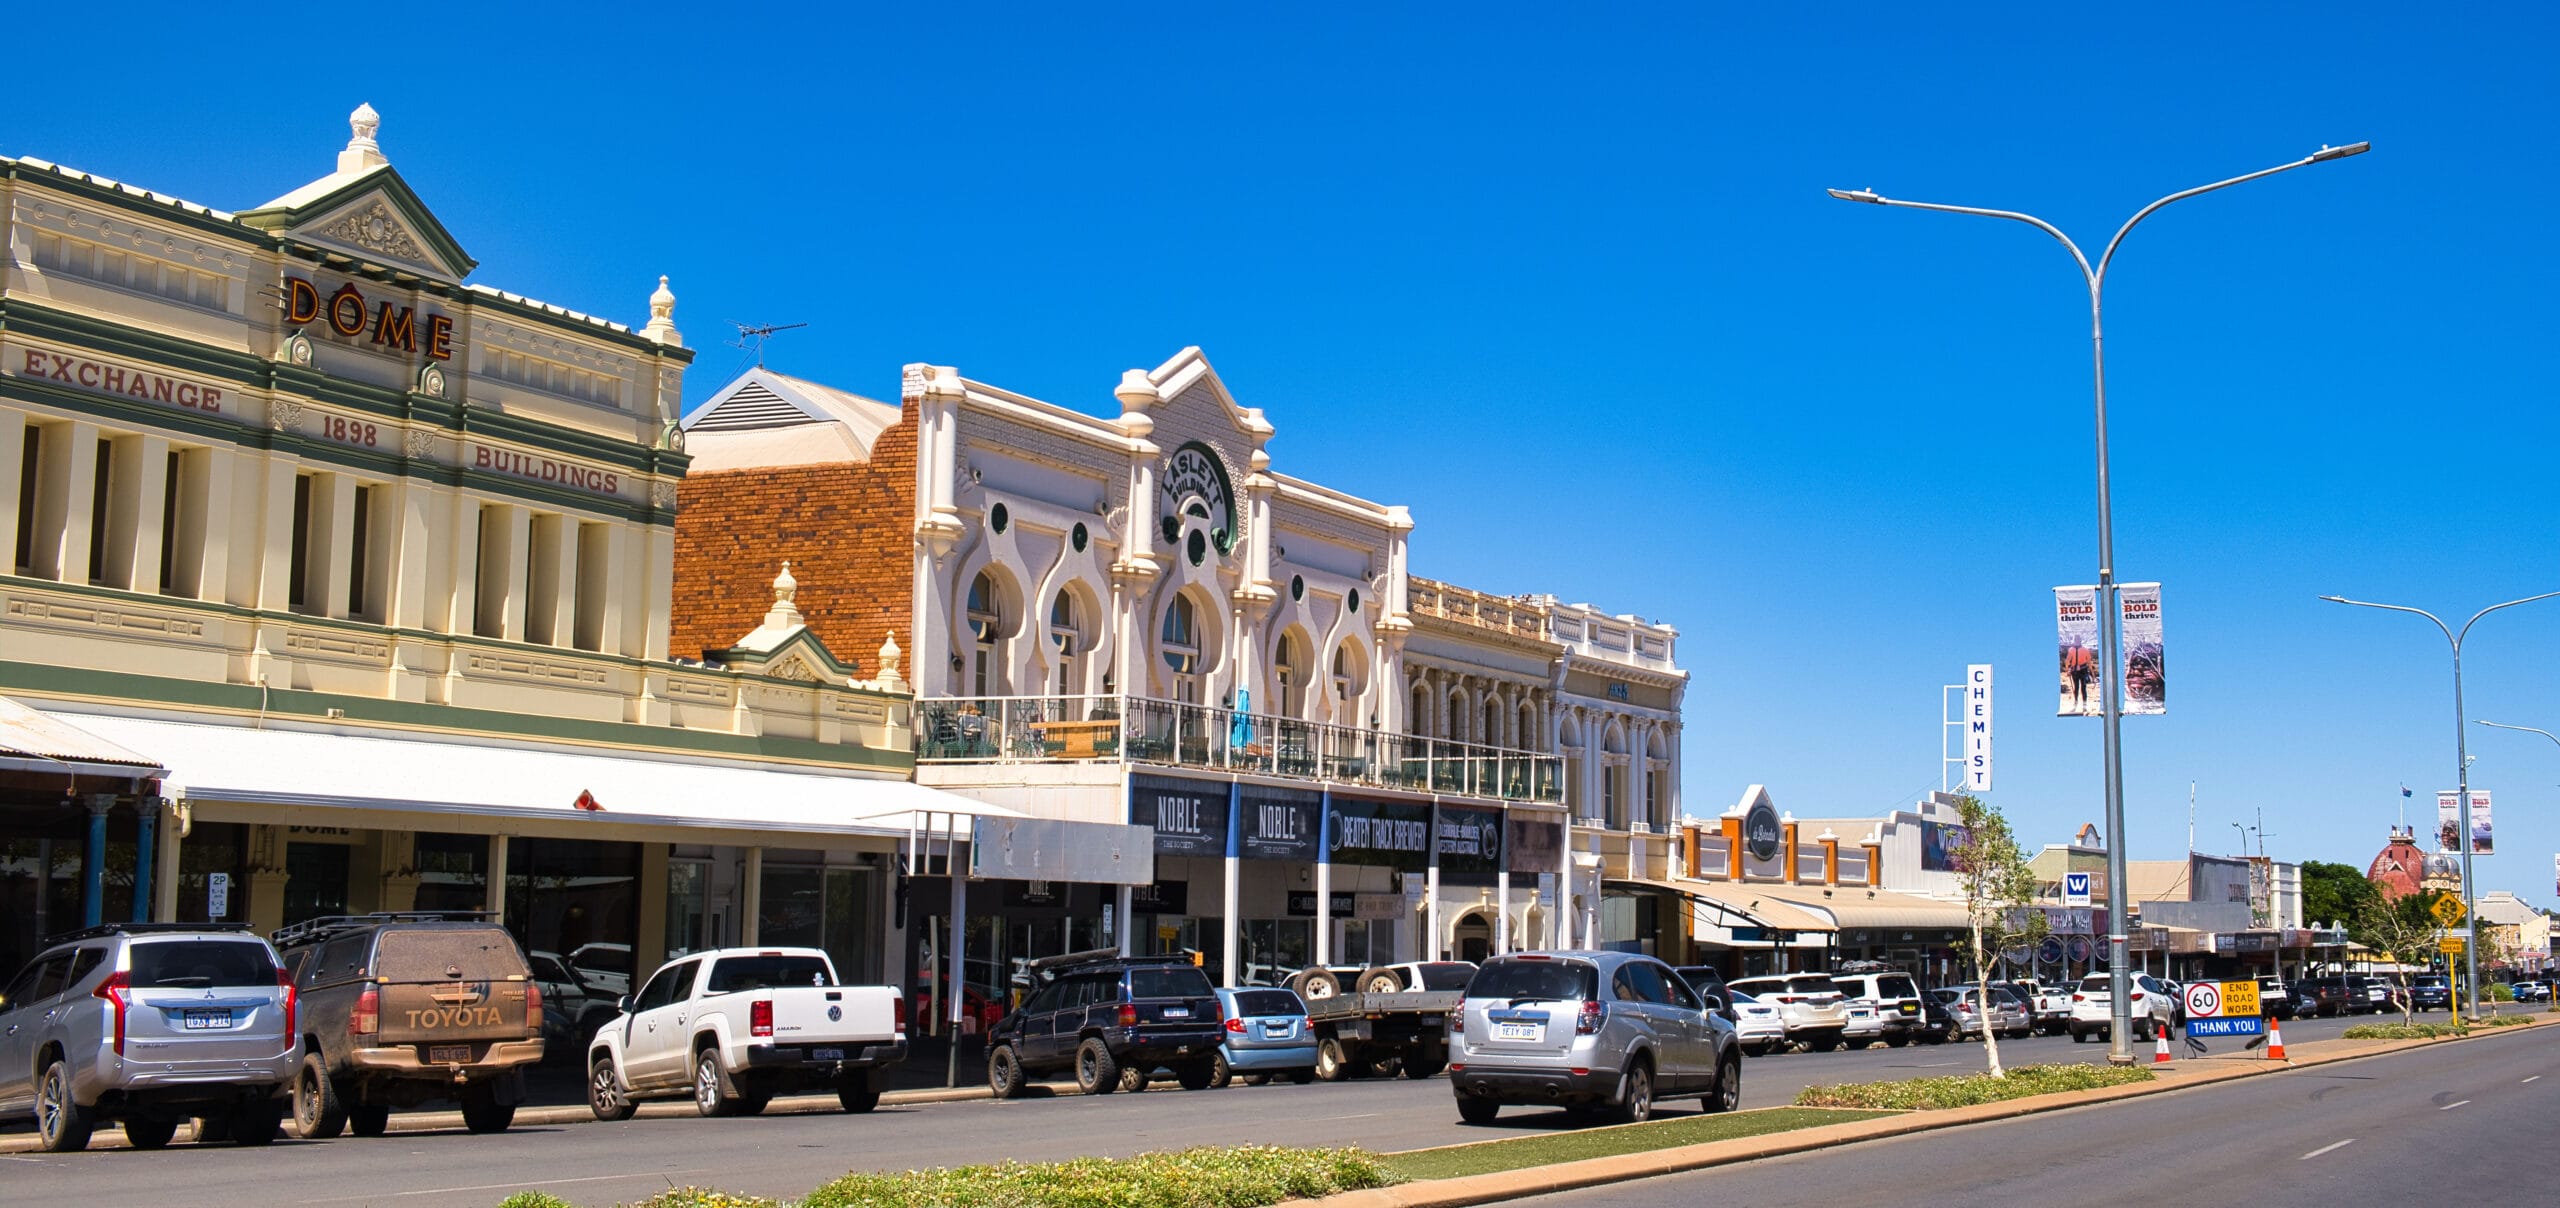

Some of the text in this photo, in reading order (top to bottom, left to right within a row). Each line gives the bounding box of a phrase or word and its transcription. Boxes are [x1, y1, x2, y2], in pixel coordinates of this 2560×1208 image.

[287, 278, 455, 360] DÔME
[24, 348, 222, 413] EXCHANGE
[322, 415, 378, 447] 1898
[474, 444, 619, 494] BUILDINGS
[1162, 453, 1224, 505] LASLETT
[1171, 477, 1214, 510] BUILDINGS
[2060, 606, 2093, 615] BOLD
[2061, 614, 2094, 622] thrive.
[2124, 604, 2158, 613] BOLD
[2125, 612, 2159, 620] thrive.
[1973, 670, 1986, 784] CHEMIST
[1158, 796, 1201, 833] NOBLE
[1259, 805, 1296, 840] NOBLE
[1344, 816, 1427, 852] BEATEN TRACK BREWERY
[213, 876, 226, 885] 2P
[1134, 885, 1161, 901] OBLE
[2229, 983, 2249, 992] END
[2192, 992, 2214, 1008] 60
[2226, 994, 2254, 1003] ROAD
[406, 1007, 503, 1029] TOYOTA
[2227, 1005, 2255, 1014] WORK
[2193, 1020, 2256, 1034] THANK YOU
